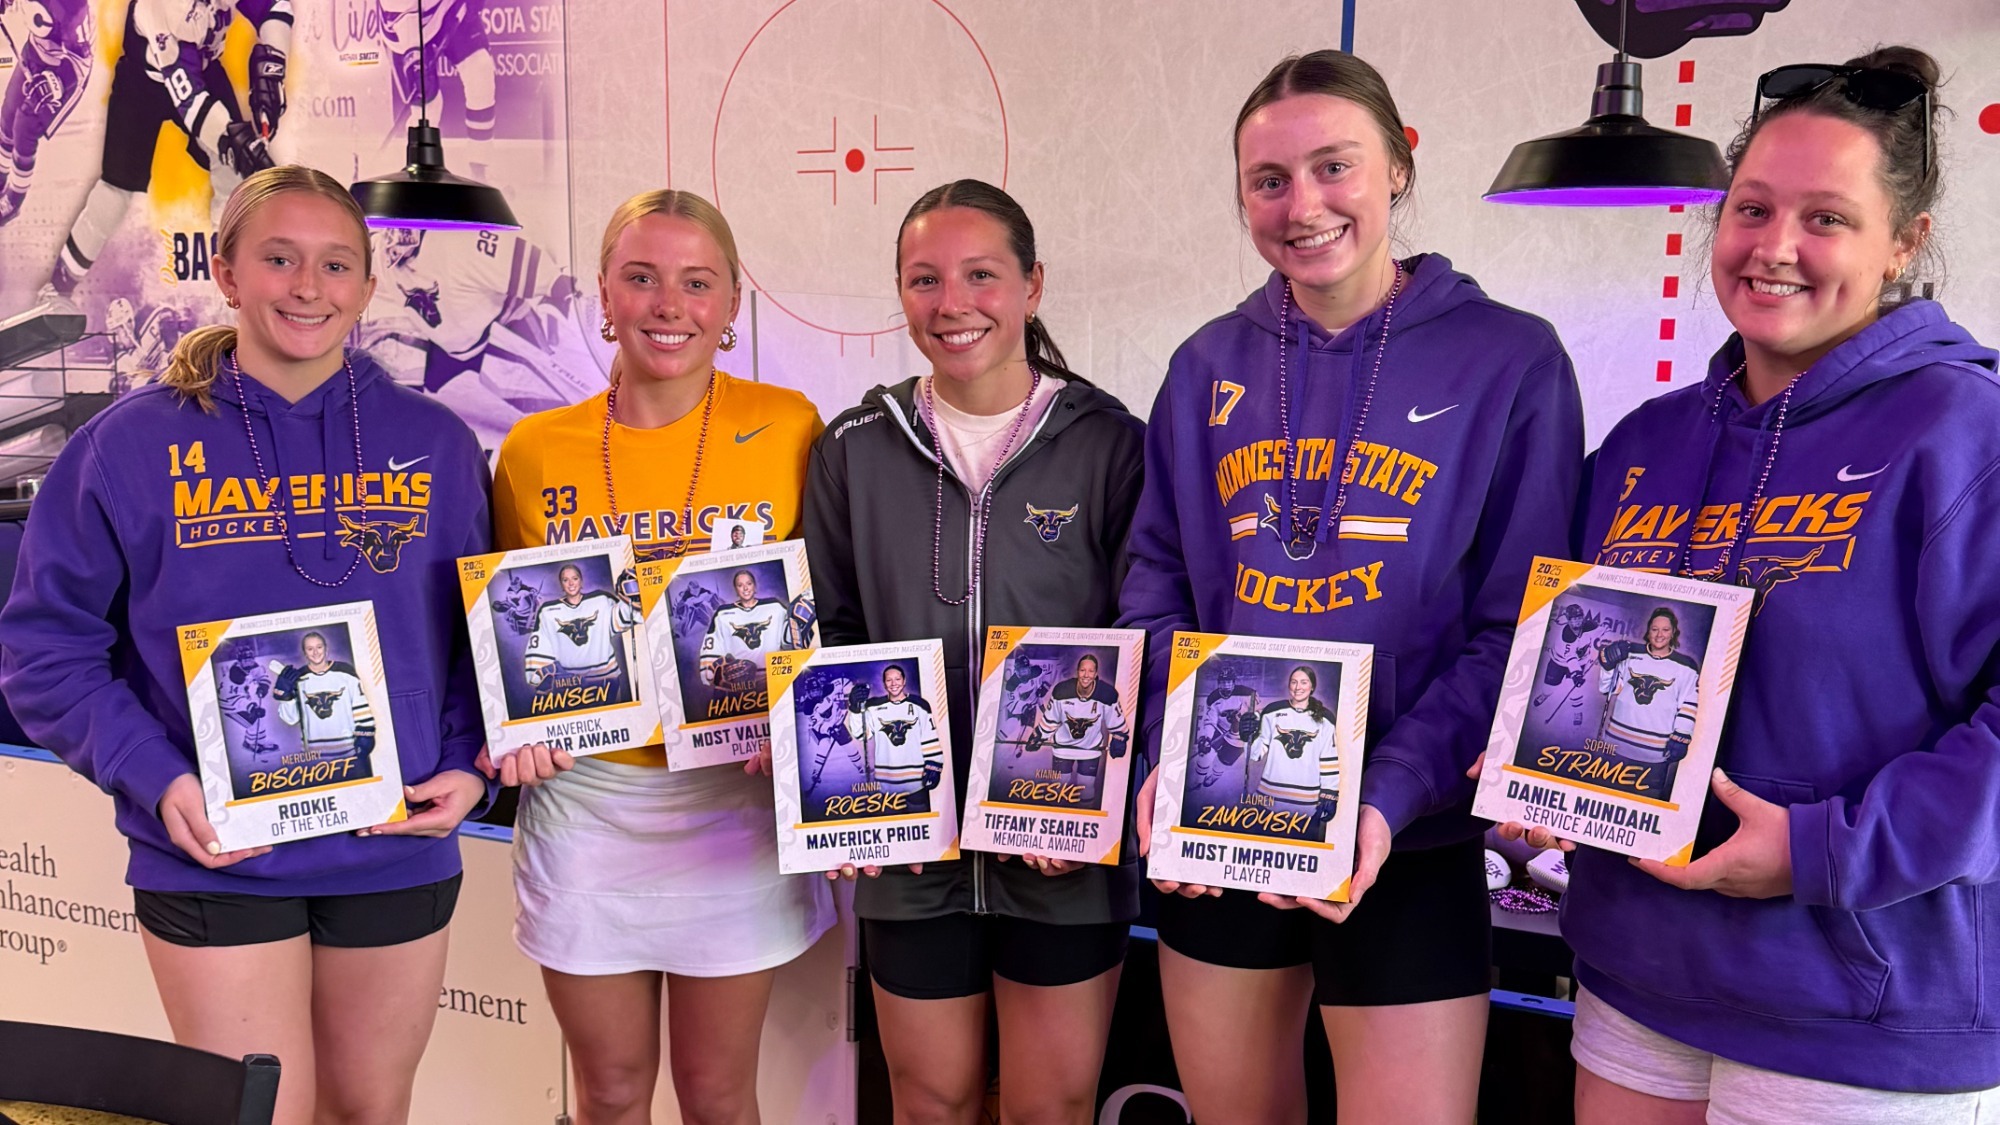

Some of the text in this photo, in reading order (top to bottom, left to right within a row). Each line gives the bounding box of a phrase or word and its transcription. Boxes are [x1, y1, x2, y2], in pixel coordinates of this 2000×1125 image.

[359, 52, 379, 60] SMITH
[495, 53, 563, 76] SSOCIATI
[165, 68, 192, 108] 18
[477, 230, 499, 258] 29
[168, 441, 207, 477] 14
[1341, 440, 1439, 506] STATE
[173, 472, 433, 518] MAVERICKS
[542, 485, 578, 518] 33
[545, 500, 776, 547] MAVERICKS
[463, 559, 484, 571] 2025
[464, 570, 486, 581] 2026
[642, 565, 662, 576] 2025
[1536, 562, 1562, 576] 2025
[643, 576, 664, 587] 2026
[1534, 575, 1560, 588] 2026
[1596, 572, 1740, 602] MINNESOTA STATE UNIVERSITY MAVERICKS
[184, 628, 208, 640] 2025
[991, 630, 1009, 640] 2025
[1177, 637, 1200, 648] 2025
[185, 639, 209, 651] 2026
[989, 641, 1008, 650] 2026
[1176, 648, 1200, 659] 2026
[1232, 640, 1361, 657] MINNESOTA STATE UNIVERSITY MAVERICKS
[771, 655, 792, 665] 2025
[771, 665, 793, 676] 2026
[555, 676, 583, 689] HAILEY
[531, 682, 611, 714] HANSEN
[546, 718, 603, 739] MAVERICK
[692, 729, 731, 749] MOST
[537, 727, 630, 752] TAR AWARD
[732, 738, 770, 756] PLAYE
[1584, 737, 1619, 756] SOPHIE
[281, 751, 322, 765] MERCURY
[1537, 746, 1652, 791] STRAMEL
[249, 756, 358, 794] BISCHOFF
[852, 781, 882, 793] KIANNA
[1008, 778, 1086, 804] ROESKE
[278, 796, 337, 820] ROOKIE
[825, 792, 909, 816] ROESKE
[1240, 793, 1275, 807] LAUREN
[1507, 780, 1662, 836] DANIEL MUNDAHL
[271, 810, 349, 837] OF THE YEAR
[985, 813, 1100, 839] TIFFANY SEARLES
[1197, 805, 1314, 835] ZAWOYSKI
[1523, 805, 1637, 848] SERVICE AWARD
[806, 824, 930, 850] MAVERICK PRIDE
[992, 831, 1085, 854] MEMORIAL AWARD
[849, 844, 890, 861] AWARD
[1181, 841, 1319, 873] MOST IMPROVED
[1223, 864, 1271, 885] PLAYER
